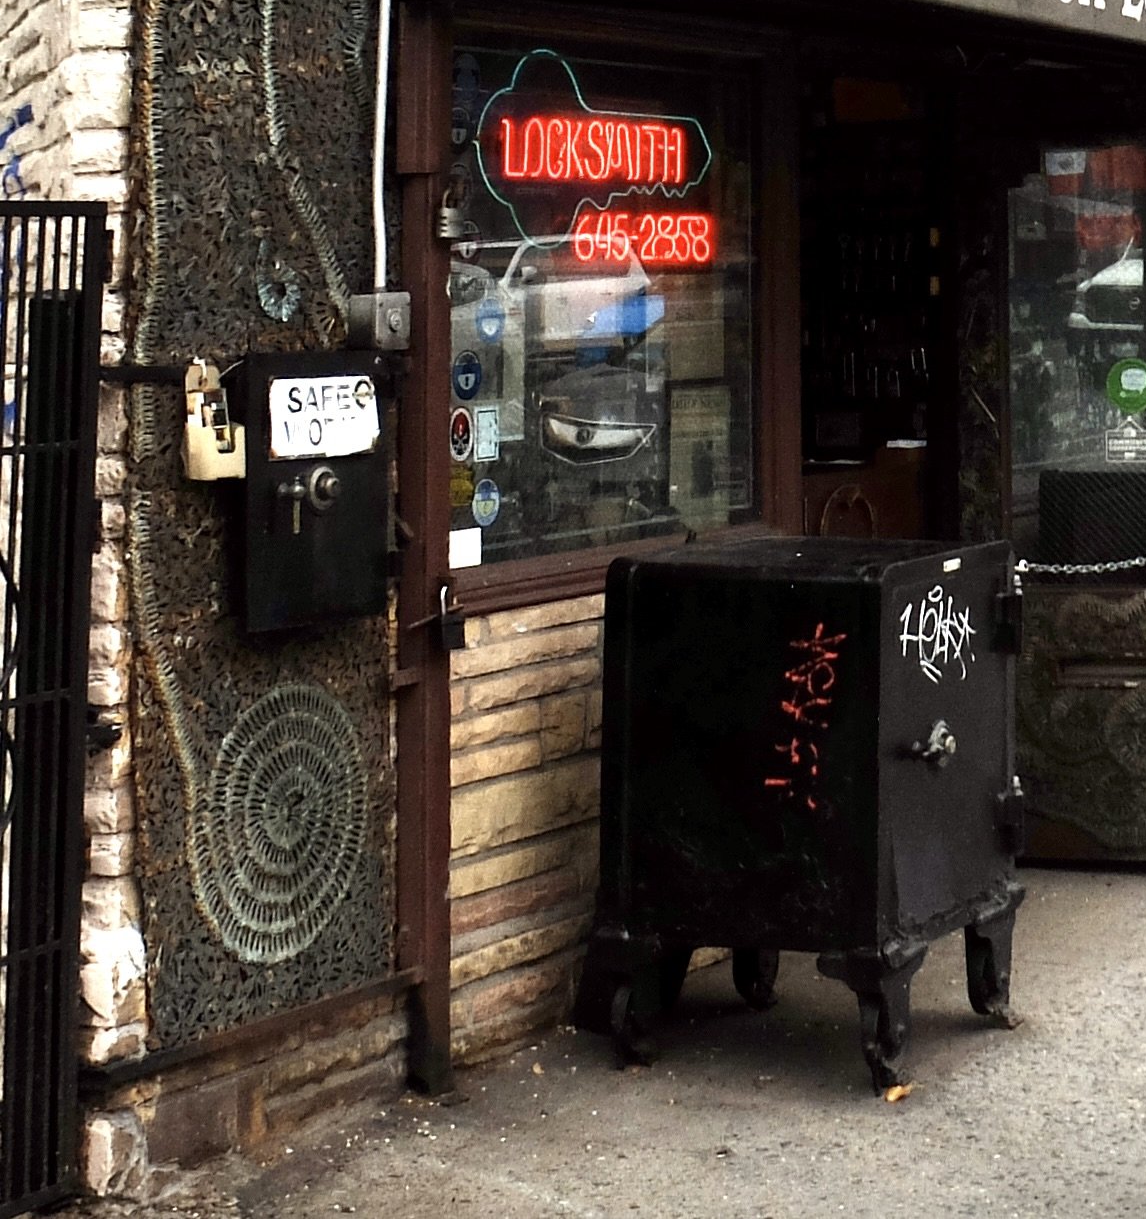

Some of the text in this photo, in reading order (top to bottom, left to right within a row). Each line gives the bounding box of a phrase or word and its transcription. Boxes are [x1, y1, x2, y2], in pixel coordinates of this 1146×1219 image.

[501, 117, 684, 183] LOCKSMITH
[575, 214, 710, 262] 645-2858
[288, 385, 350, 413] SAFE
